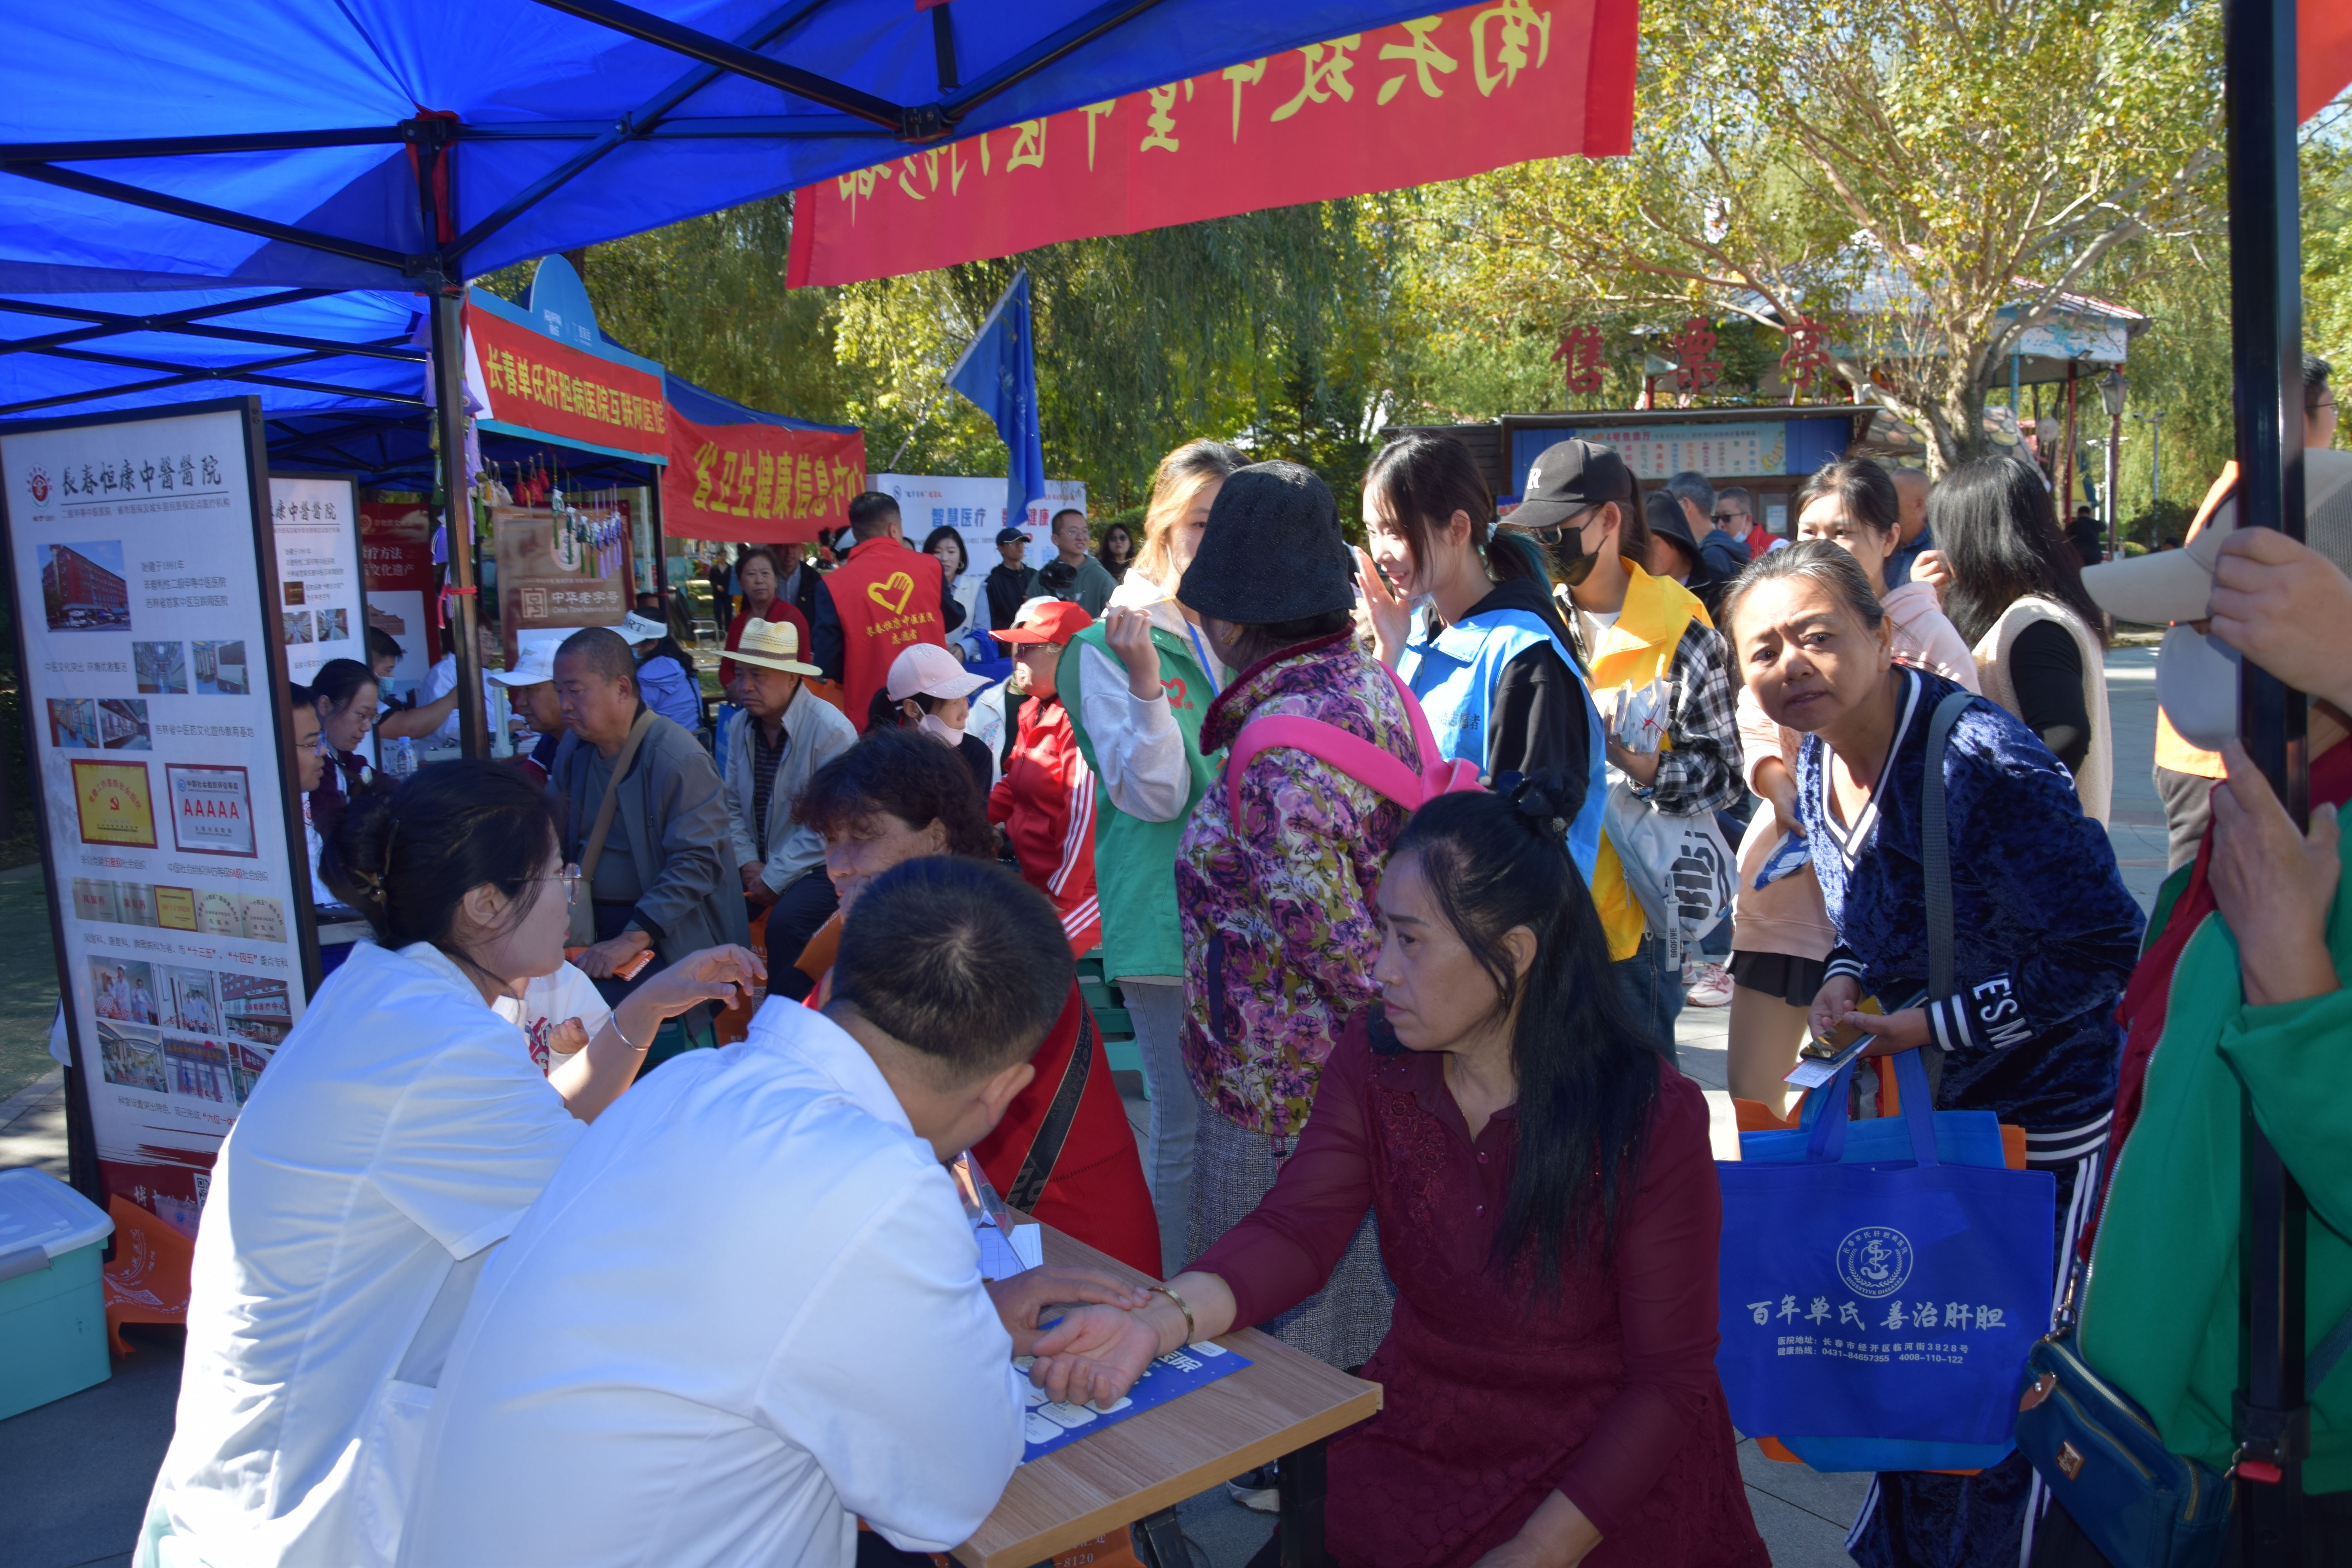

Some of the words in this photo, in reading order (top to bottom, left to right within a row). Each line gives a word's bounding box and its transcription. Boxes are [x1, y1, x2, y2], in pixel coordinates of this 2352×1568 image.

[1551, 315, 1831, 394] 售票亭
[487, 343, 665, 434] 长春单氏肝胆病医院互联网医院
[693, 440, 866, 520] 省卫生健康信息中心
[1526, 468, 1542, 489] R
[270, 499, 336, 521] 康中醫醫院
[932, 508, 986, 528] 智慧医疗
[142, 560, 185, 572] 始建于1991年
[144, 577, 227, 590] 非营利性二级甲等中医医院
[146, 595, 229, 608] 吉林省首家中医互联网医院
[551, 591, 619, 604] 中华老字号
[891, 629, 918, 645] 志愿者
[45, 662, 85, 673] 中医文化突出
[87, 662, 128, 673] 环境优雅整洁
[155, 724, 254, 738] 吉林省中医药文化宣传教育基地
[89, 778, 142, 810] 党建工作星级社会组织
[187, 780, 239, 790] 中国社会组织评估等级
[184, 798, 240, 820] AAAAA
[81, 855, 147, 870] 非公党建五星级社会组织
[124, 898, 146, 910] 康复科
[1843, 1230, 1908, 1254] 长春单氏肝胆病医院
[1846, 1276, 1877, 1295] DIGESTIVE
[1878, 1276, 1903, 1295] DISEASES
[1746, 1294, 1866, 1331] 百年单氏
[1880, 1300, 2006, 1331] 善治肝胆
[1778, 1336, 1817, 1345] 医院地址：
[1822, 1338, 1969, 1353] 长春市经开区临河街3828号
[1777, 1346, 1817, 1356] 健康热线：
[1822, 1348, 1889, 1362] 0431-84657355
[1899, 1354, 1963, 1364] 4008-110-122
